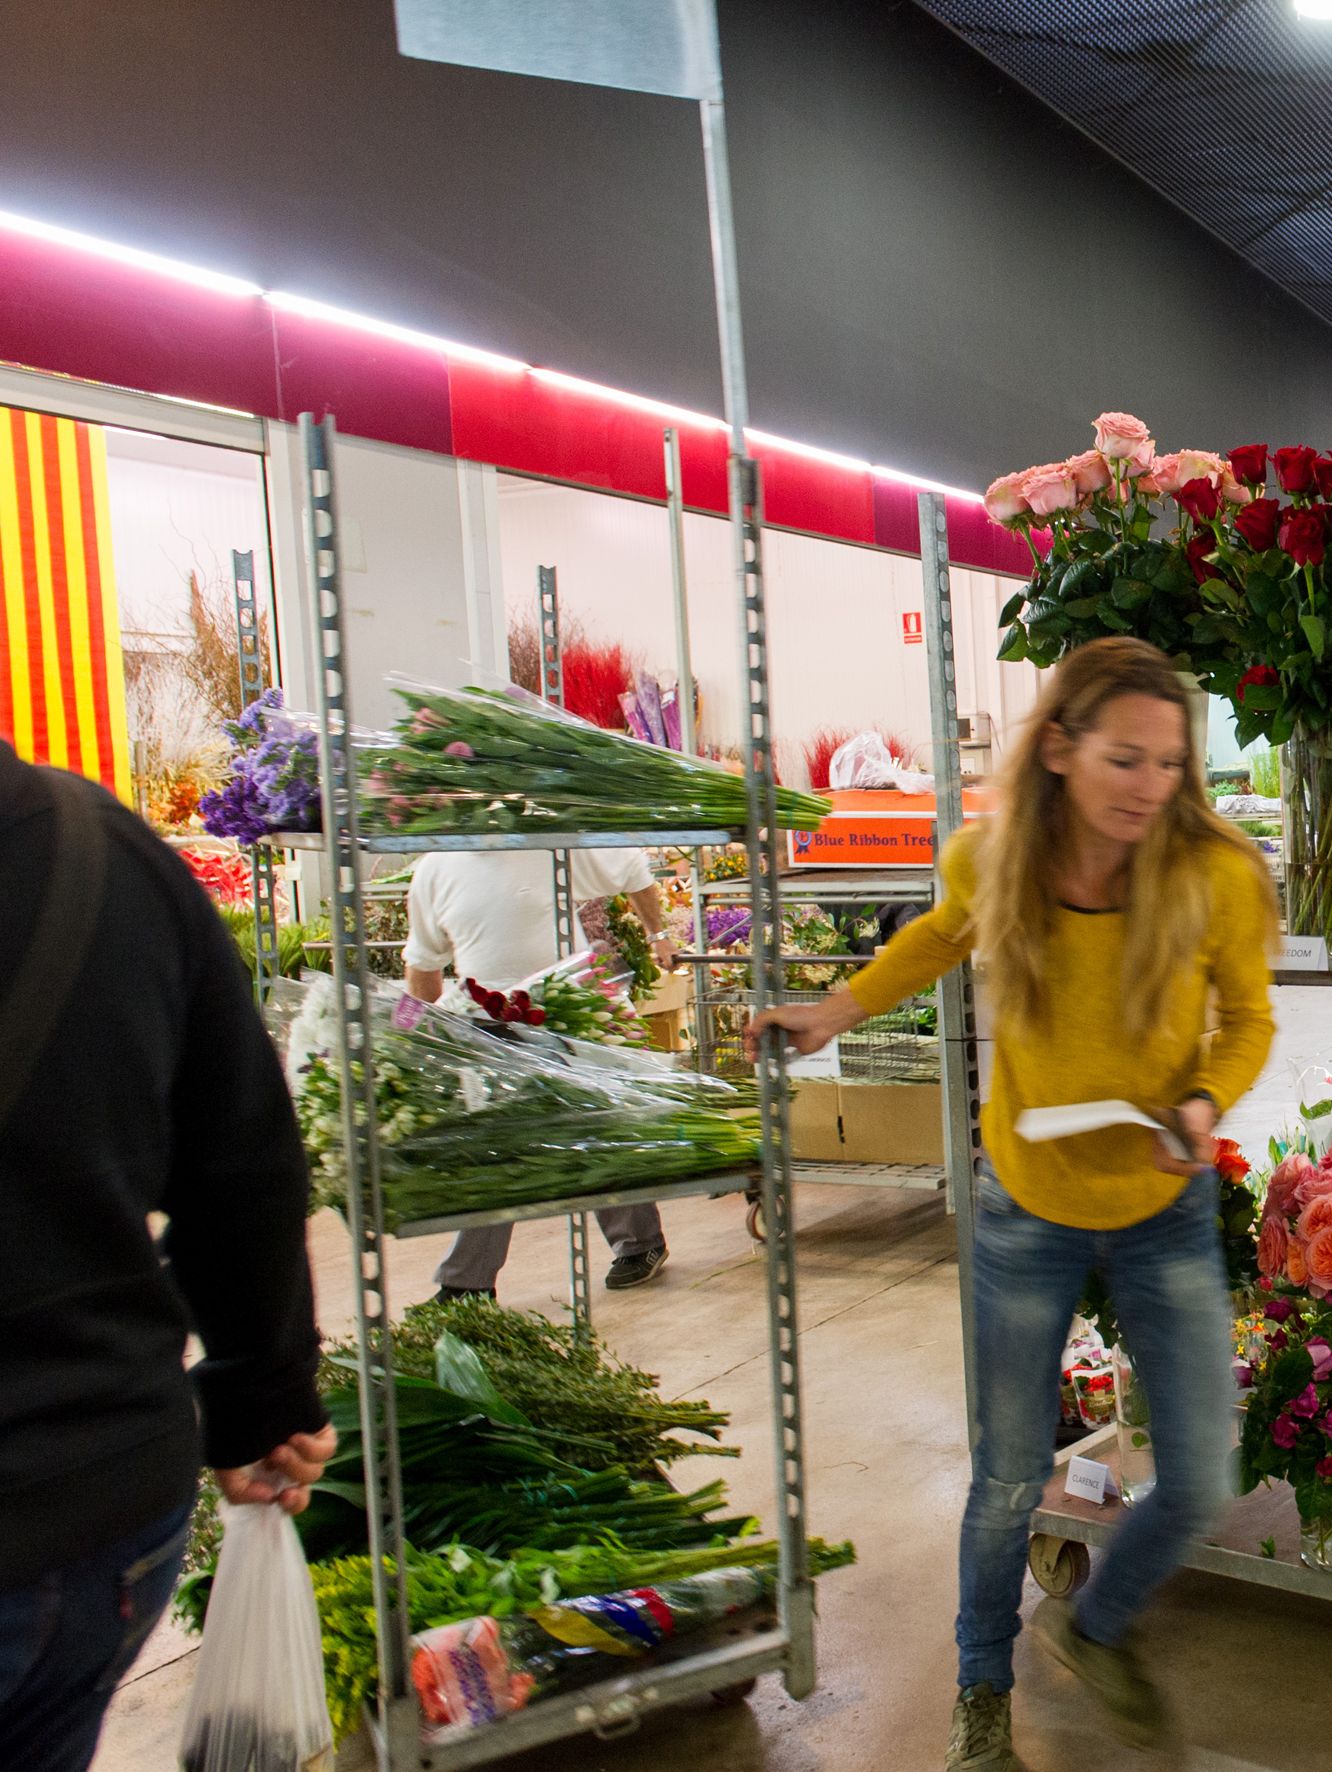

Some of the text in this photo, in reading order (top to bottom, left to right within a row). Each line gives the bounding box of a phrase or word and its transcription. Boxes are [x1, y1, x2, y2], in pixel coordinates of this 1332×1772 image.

[814, 833, 845, 846] Blue
[849, 833, 898, 846] Ribbon
[1072, 1474, 1100, 1490] CLARENCE
